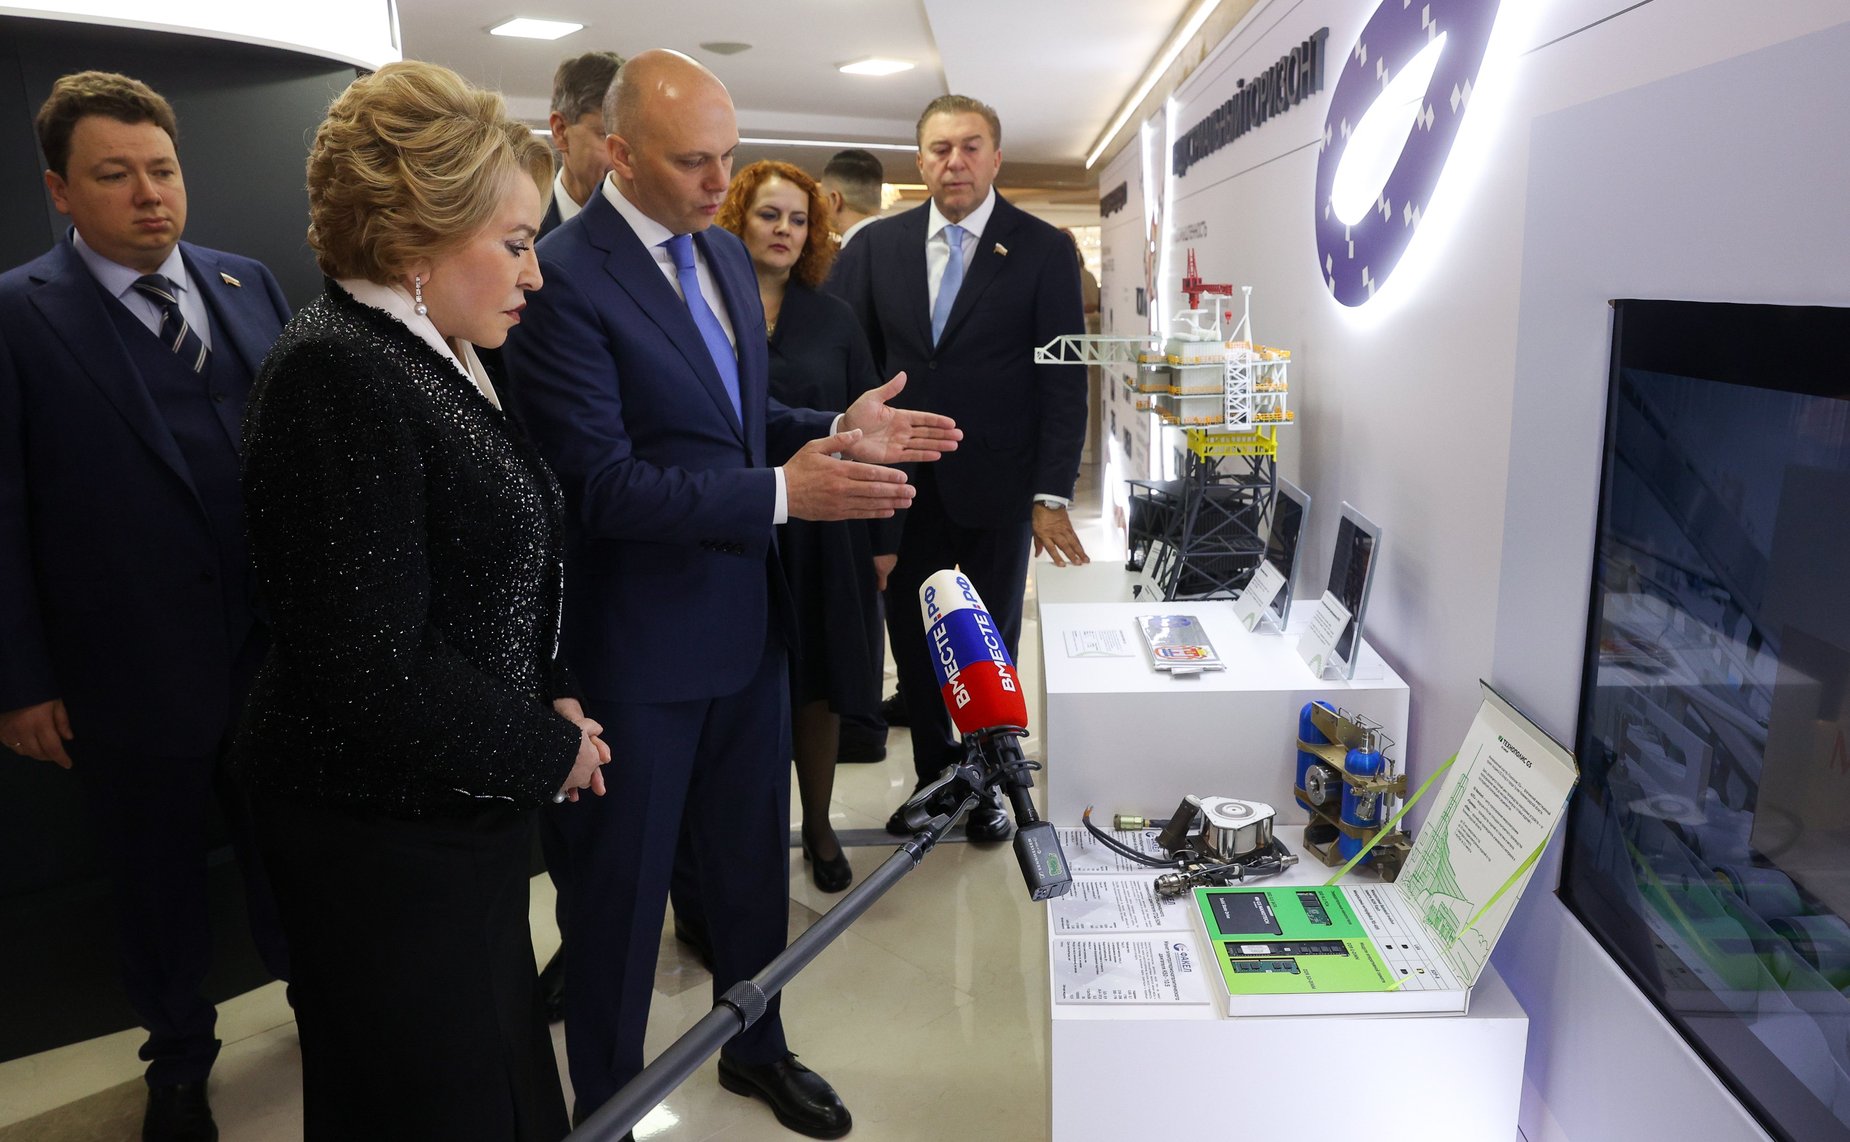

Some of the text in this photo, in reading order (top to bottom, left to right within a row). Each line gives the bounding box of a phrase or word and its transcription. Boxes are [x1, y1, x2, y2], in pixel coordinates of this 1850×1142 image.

[1245, 27, 1329, 131] ГОРИЗОНТ
[933, 622, 971, 709] ВМЕСТЕ
[974, 613, 1016, 692] ВМЕСТЕ
[1028, 838, 1042, 871] SENNHEISER
[1180, 952, 1192, 972] ФАКЕЛ
